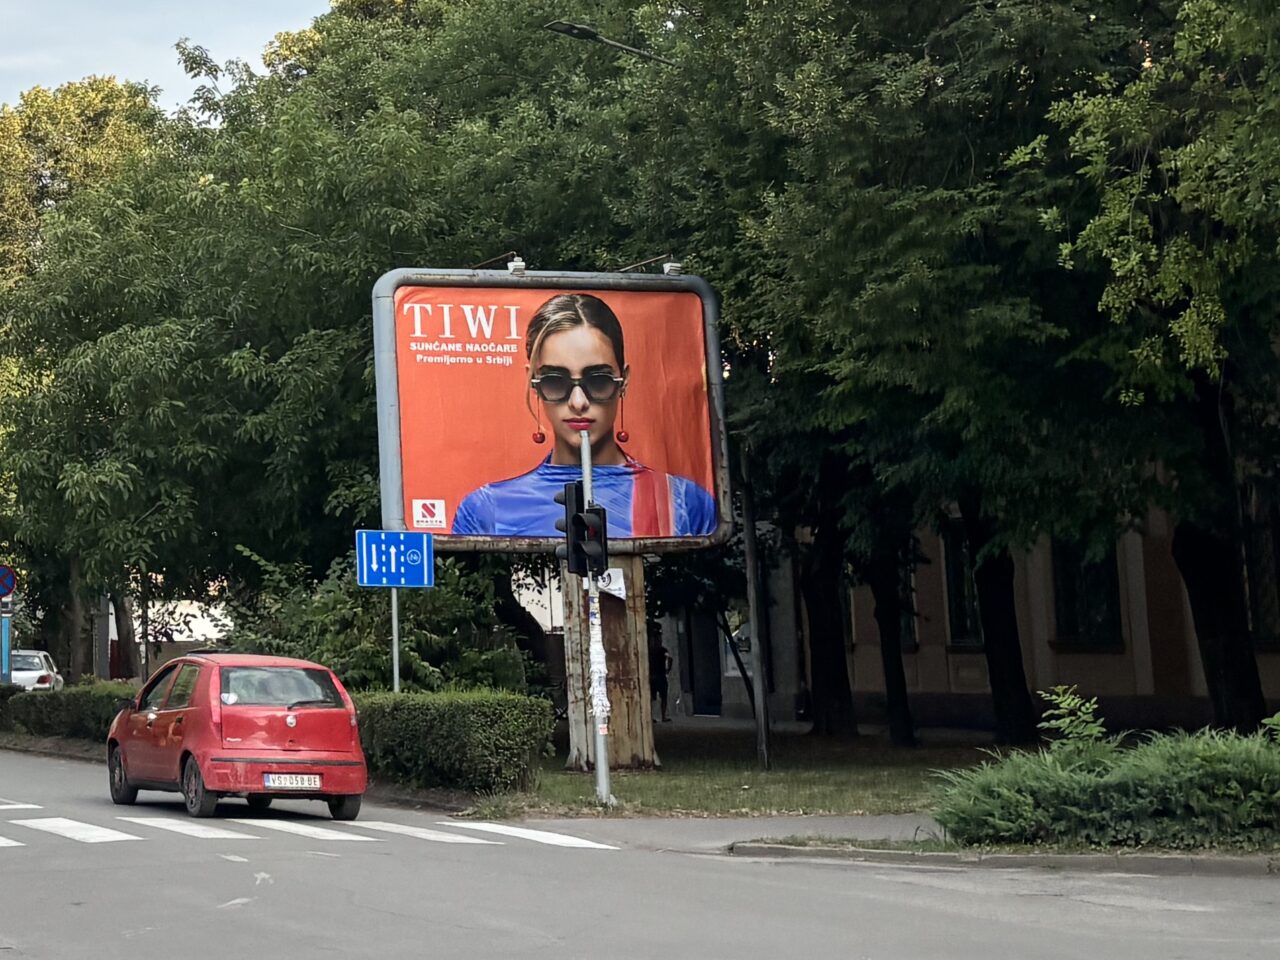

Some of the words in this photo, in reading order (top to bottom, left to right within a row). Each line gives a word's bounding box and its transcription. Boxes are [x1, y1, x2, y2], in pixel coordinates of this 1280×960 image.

[403, 303, 523, 339] TIWI
[409, 341, 463, 352] SUNČANE
[465, 342, 518, 353] NAOČARE
[416, 354, 474, 365] Premijerno
[485, 355, 513, 366] Srbiji
